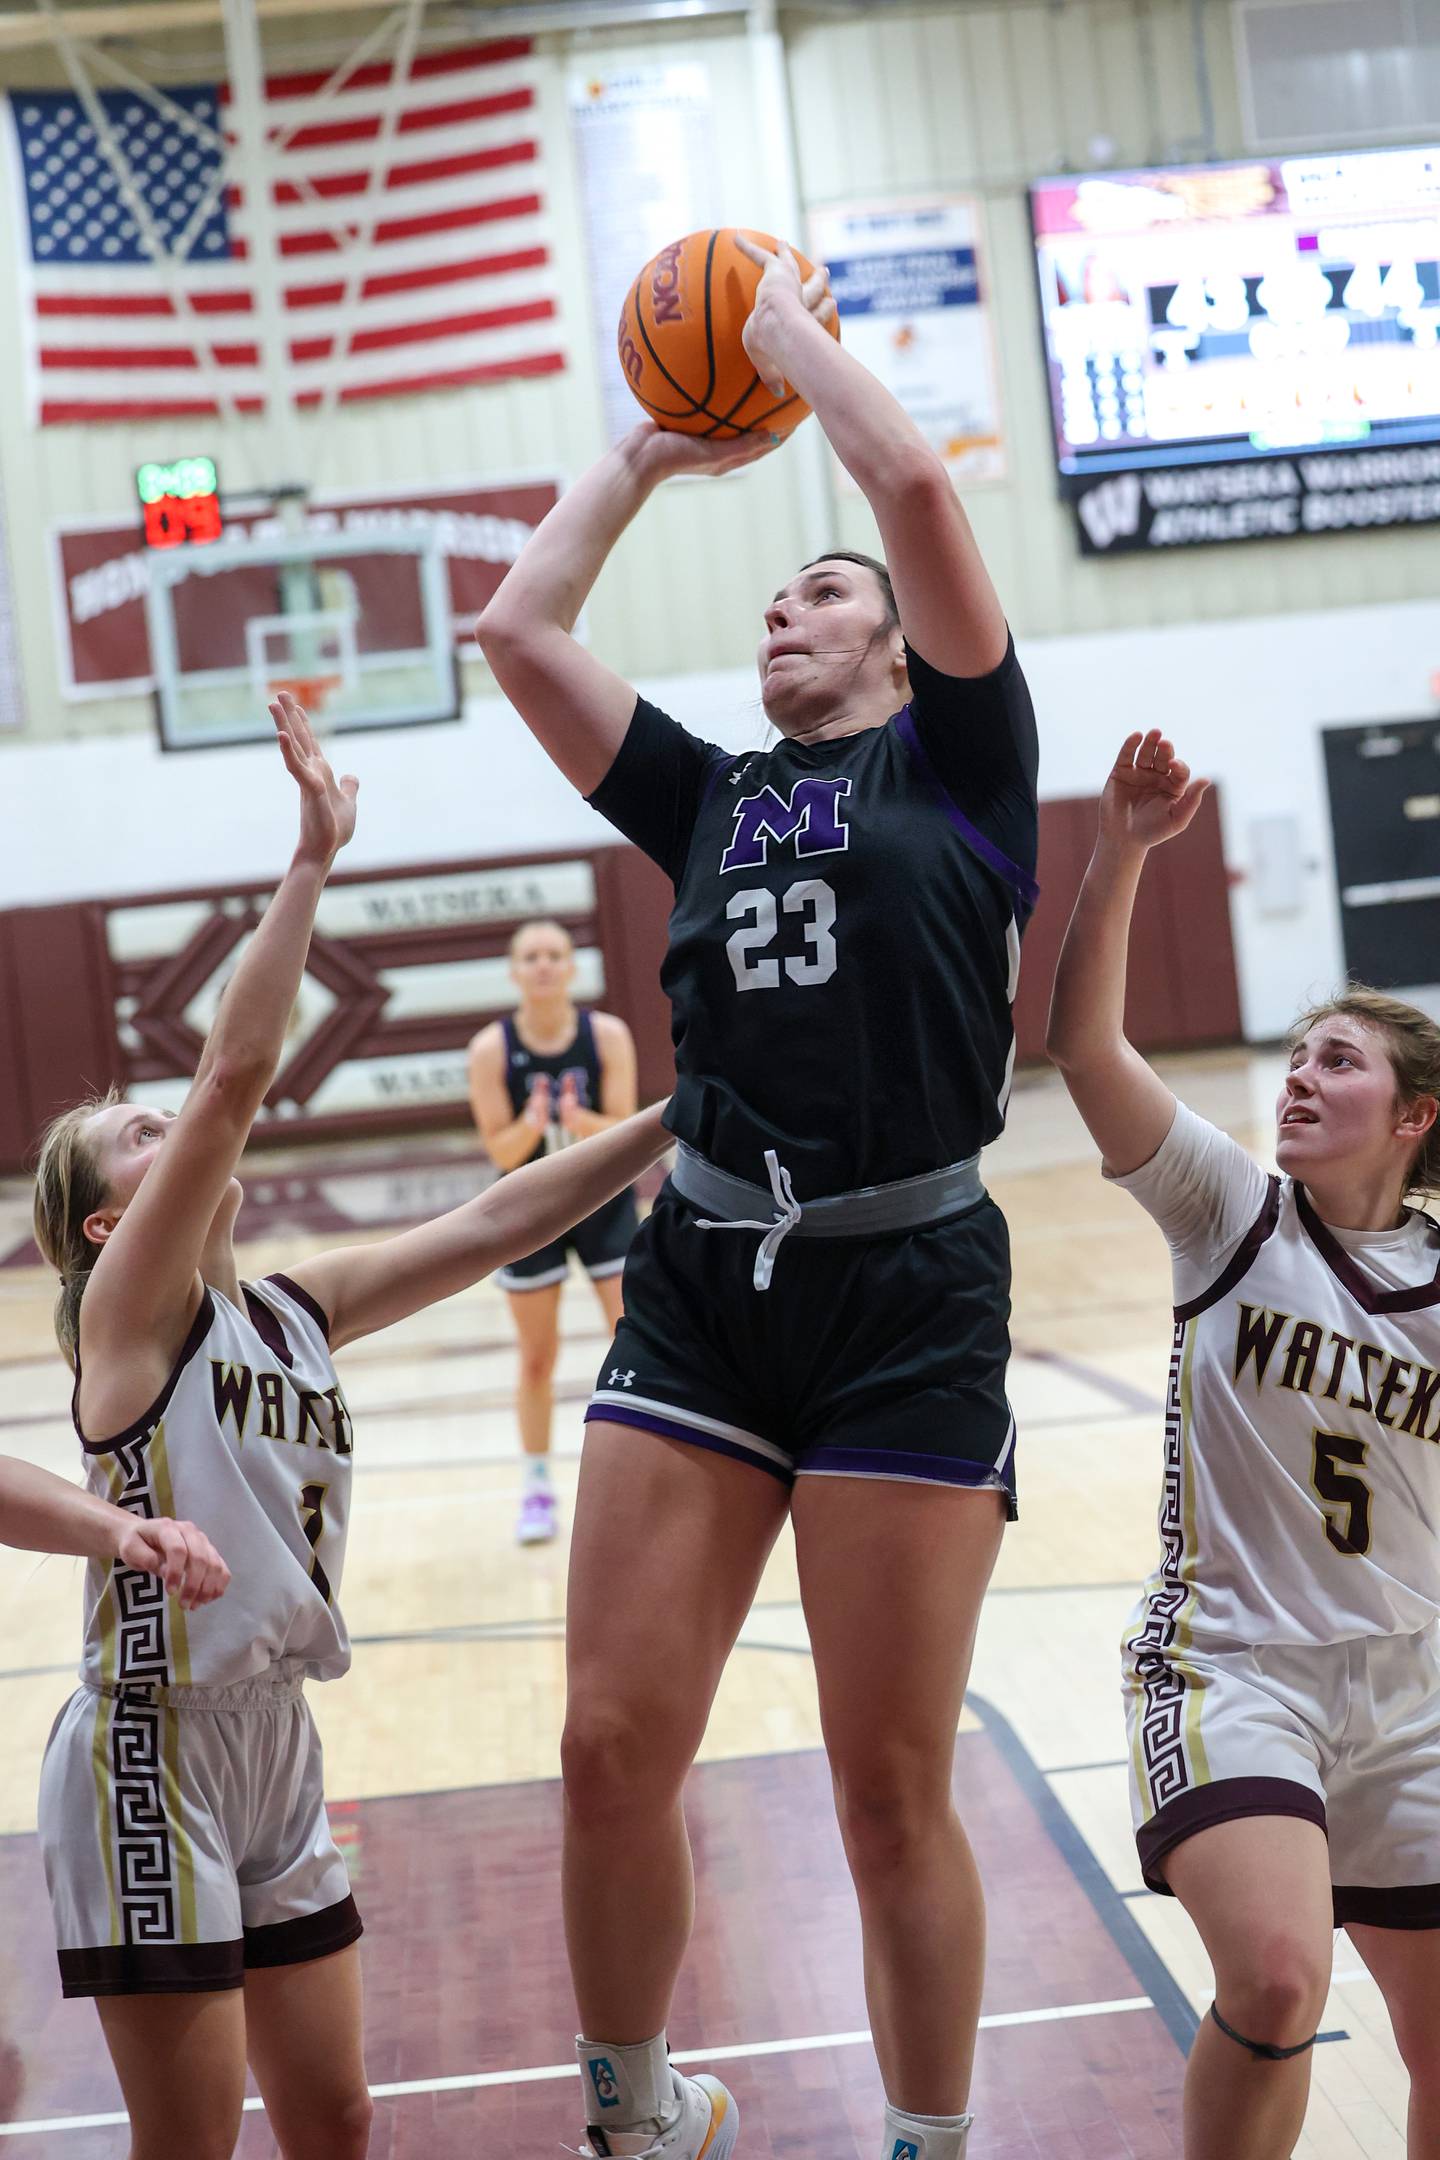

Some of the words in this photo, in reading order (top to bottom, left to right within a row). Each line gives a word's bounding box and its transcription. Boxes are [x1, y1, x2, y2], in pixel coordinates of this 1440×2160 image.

[1144, 460, 1301, 508] WATSEKA
[719, 777, 852, 874] M
[725, 879, 838, 992] 23
[1312, 1428, 1374, 1557] 5
